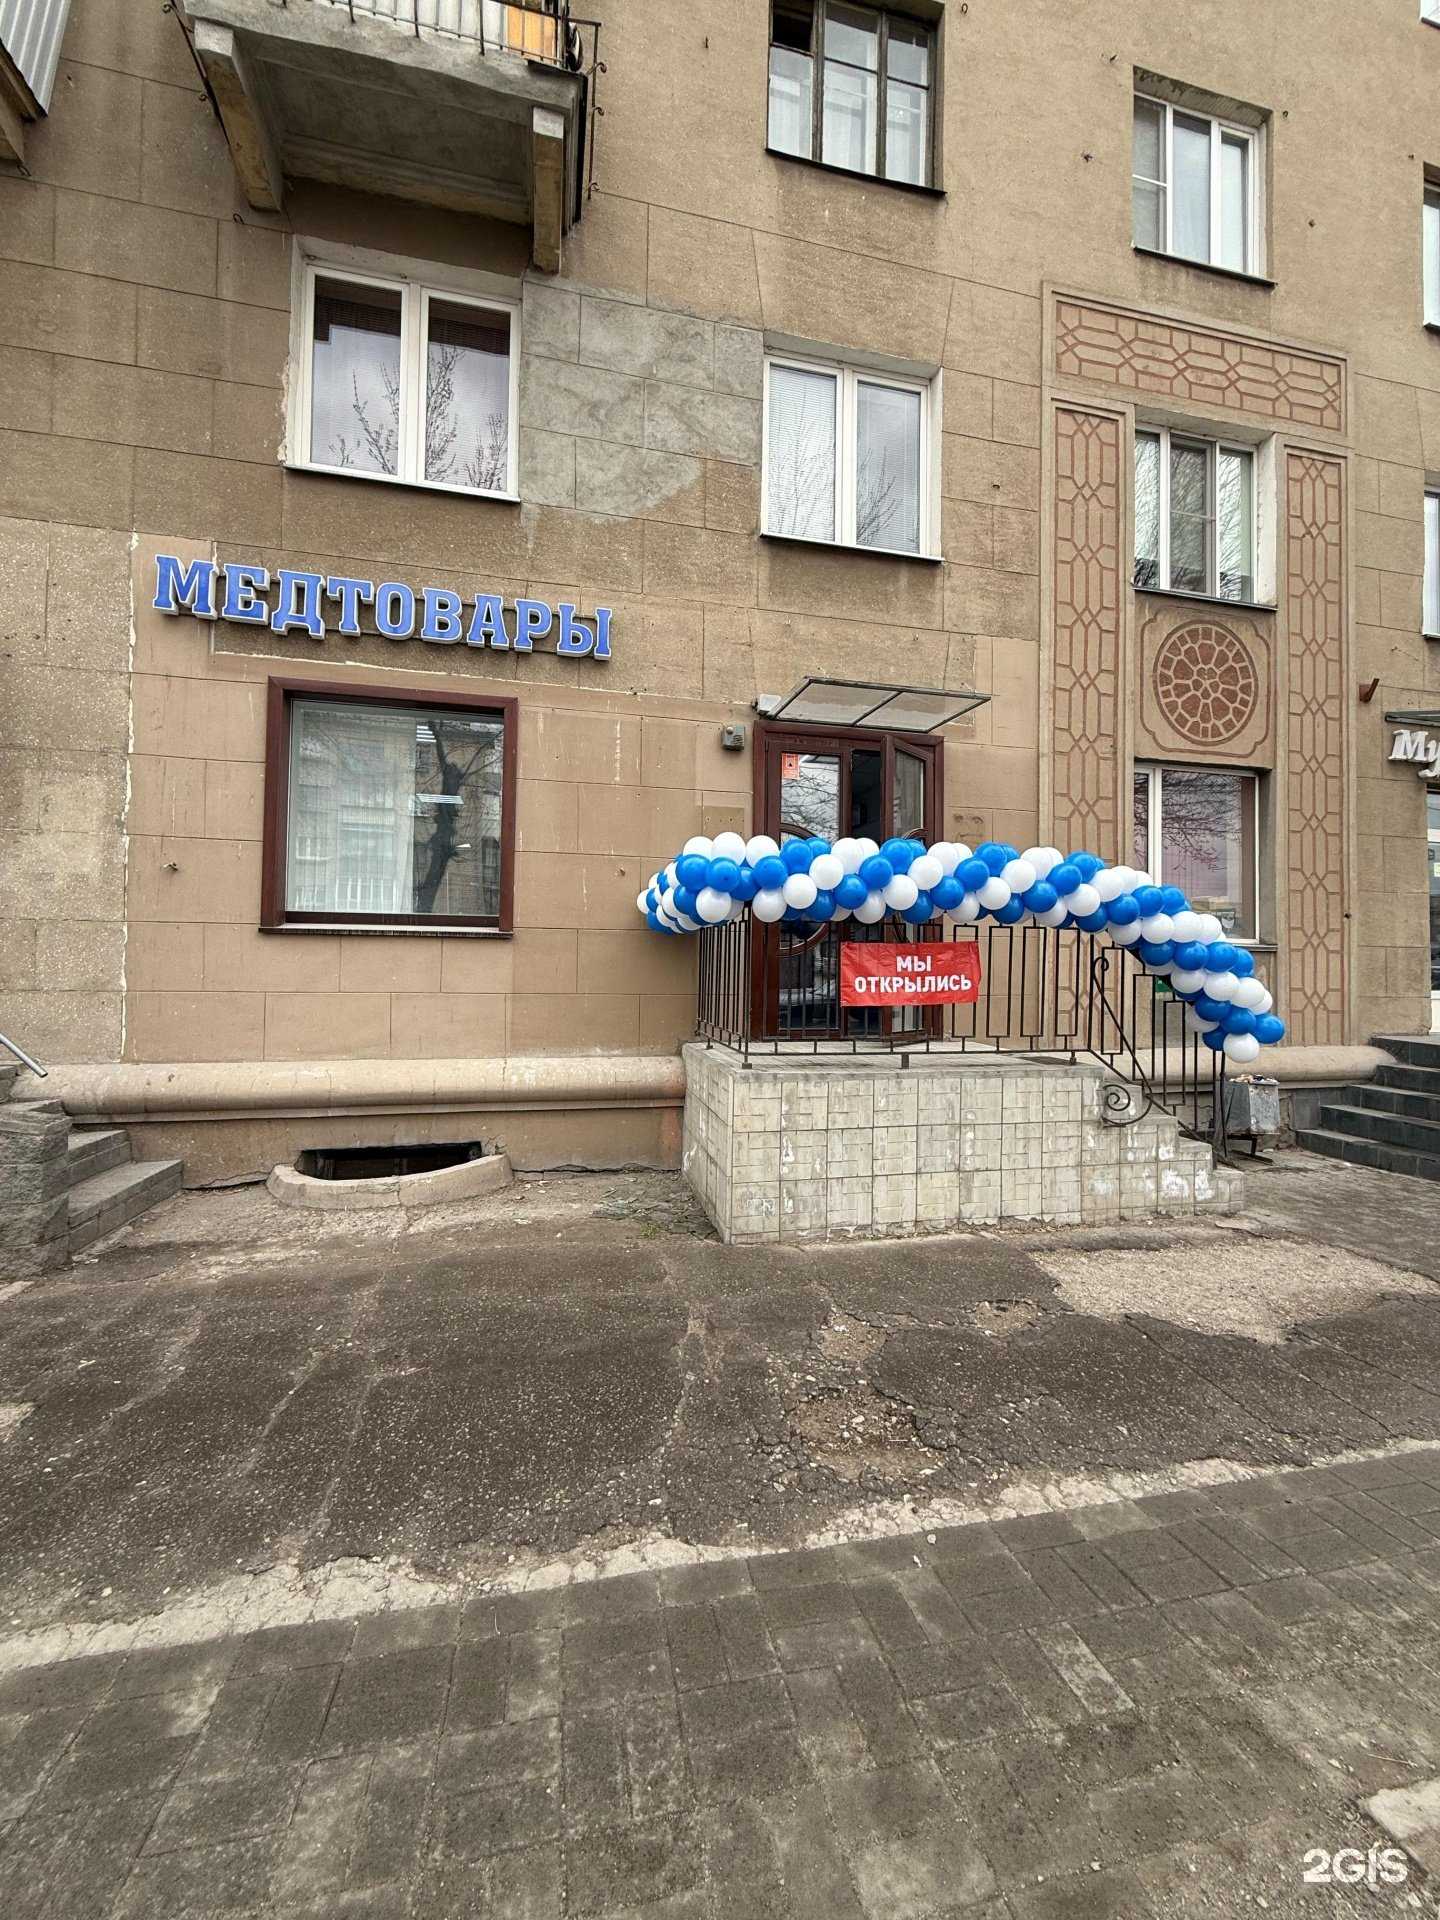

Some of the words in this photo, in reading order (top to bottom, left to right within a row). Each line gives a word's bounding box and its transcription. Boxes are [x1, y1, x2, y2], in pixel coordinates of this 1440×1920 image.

[152, 554, 613, 661] МЕДТОВАРЫ
[896, 955, 932, 972] МЫ
[854, 974, 973, 993] ОТКРЫЛИСЬ
